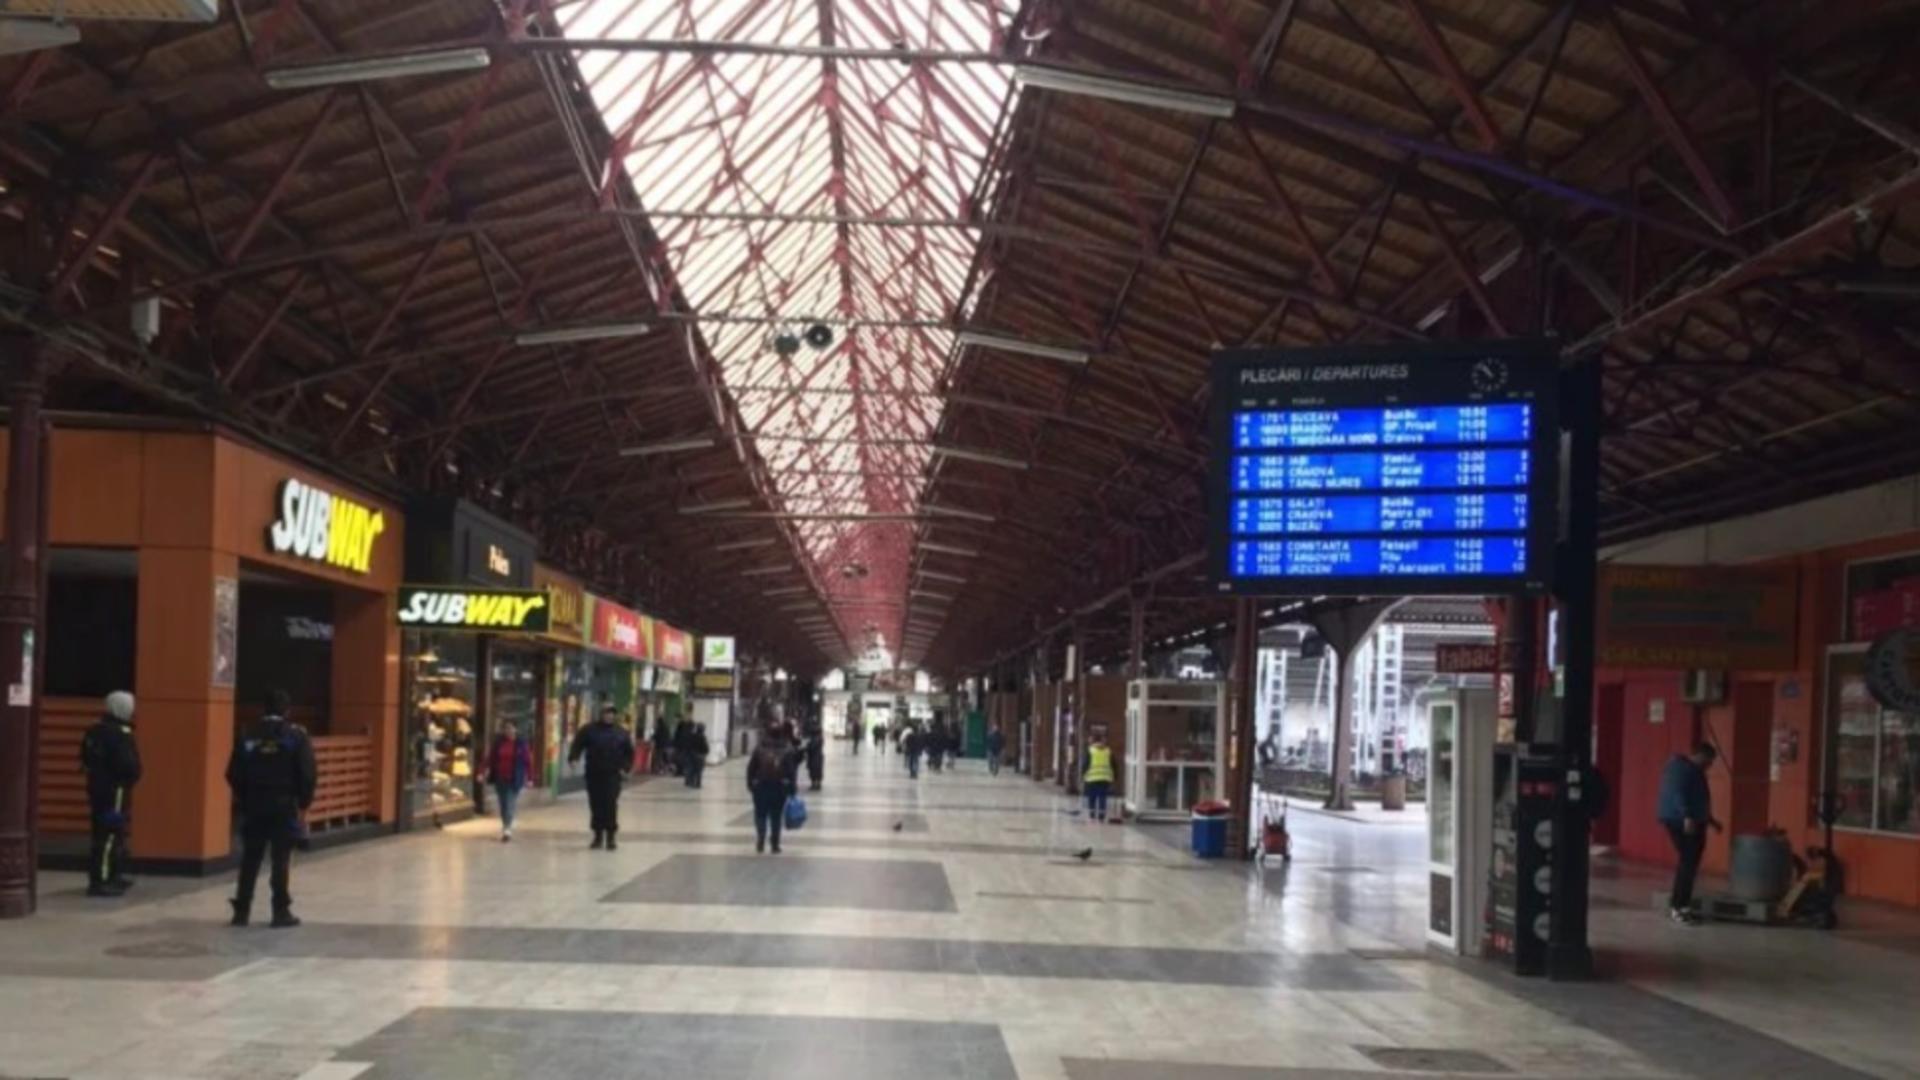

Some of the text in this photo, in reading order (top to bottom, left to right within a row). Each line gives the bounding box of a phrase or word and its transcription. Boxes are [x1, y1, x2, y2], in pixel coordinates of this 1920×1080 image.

[1312, 364, 1408, 381] DEPARTURES
[1290, 412, 1339, 423] SUCEAVA
[1348, 432, 1377, 444] NORD
[1383, 432, 1424, 443] Craiova
[1289, 465, 1334, 477] CRAIOVA
[1514, 494, 1527, 505] 10
[1288, 508, 1334, 520] CRAIOVA
[1514, 505, 1526, 515] 11
[271, 478, 384, 573] SUBWAY
[1512, 560, 1525, 571] 10
[398, 591, 545, 627] SUBWAY
